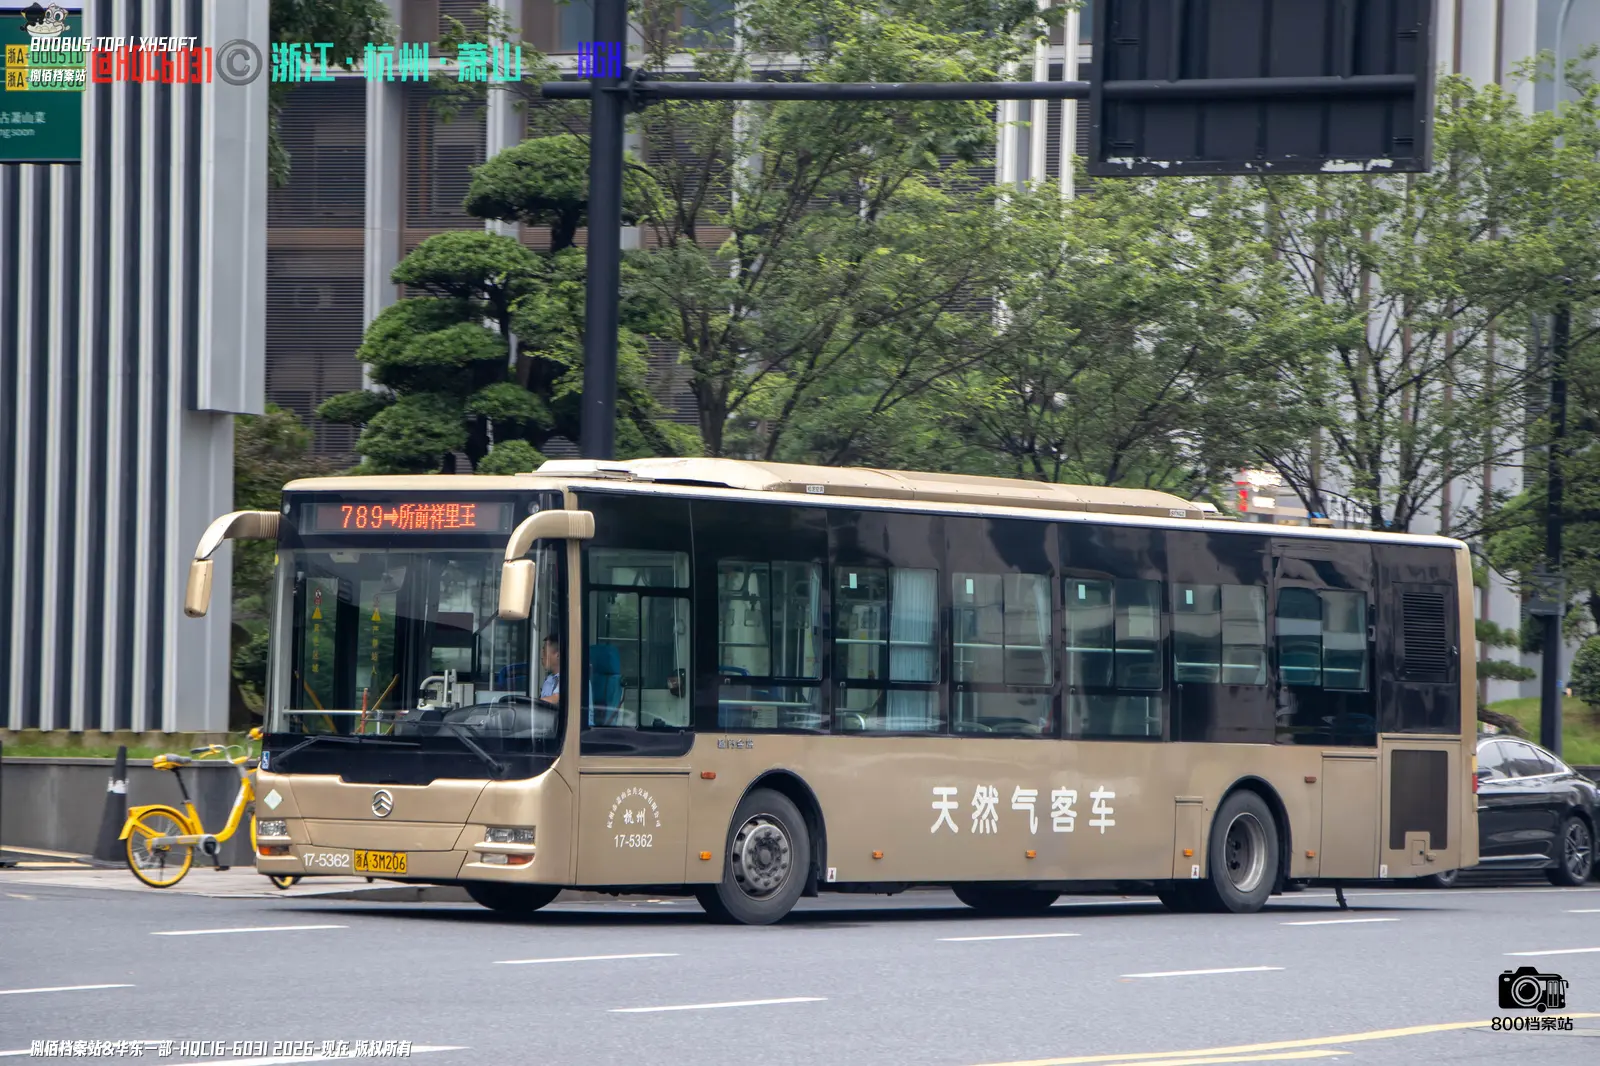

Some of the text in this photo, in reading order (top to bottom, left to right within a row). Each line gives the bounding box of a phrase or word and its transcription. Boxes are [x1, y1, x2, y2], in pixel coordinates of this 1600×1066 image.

[341, 505, 383, 529] 789
[623, 807, 646, 827] 杭州
[930, 784, 1116, 835] 天然气客车
[614, 833, 653, 848] 17-5362
[303, 853, 350, 868] 17-5362
